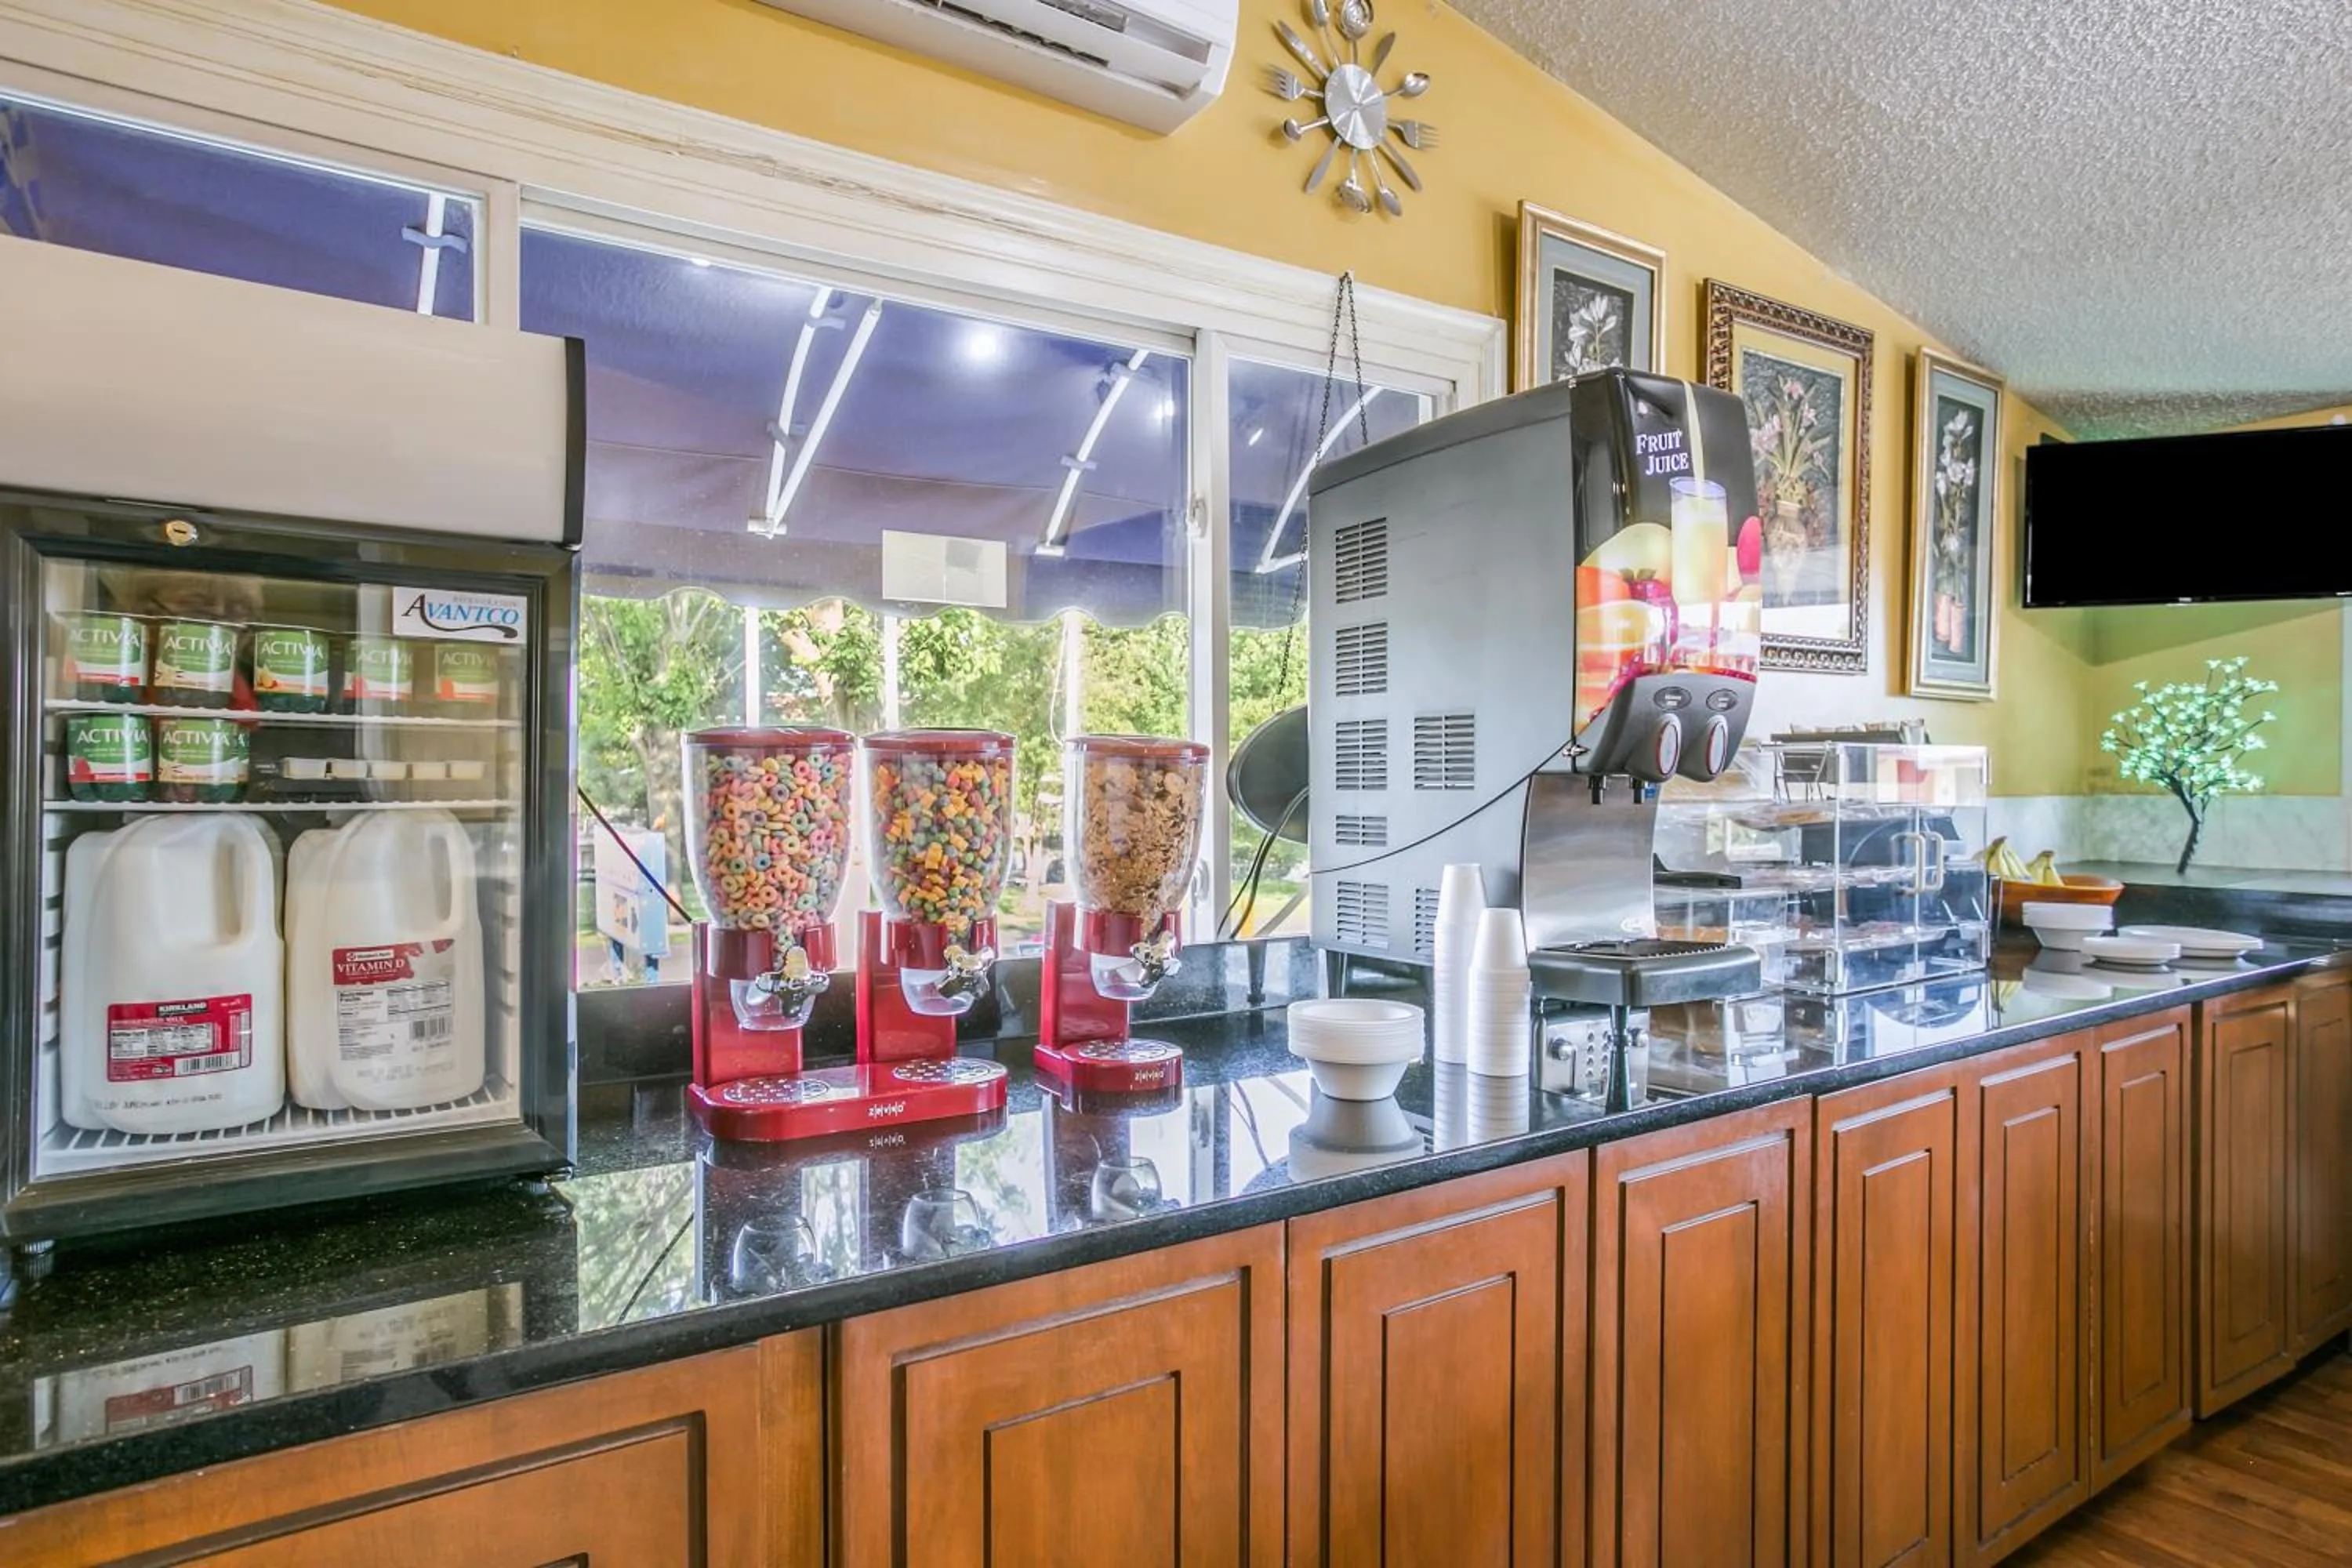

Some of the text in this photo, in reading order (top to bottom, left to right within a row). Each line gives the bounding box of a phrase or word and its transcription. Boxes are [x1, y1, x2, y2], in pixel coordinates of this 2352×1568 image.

[1635, 429, 1682, 454] FRUIT
[1646, 452, 1689, 475] JUICE
[401, 593, 519, 638] AVANTCO
[261, 641, 324, 659] ACTIVIA
[77, 728, 148, 744] ACTIVIA
[336, 959, 405, 973] VITAMIN D
[158, 1002, 207, 1013] KIRKLAND
